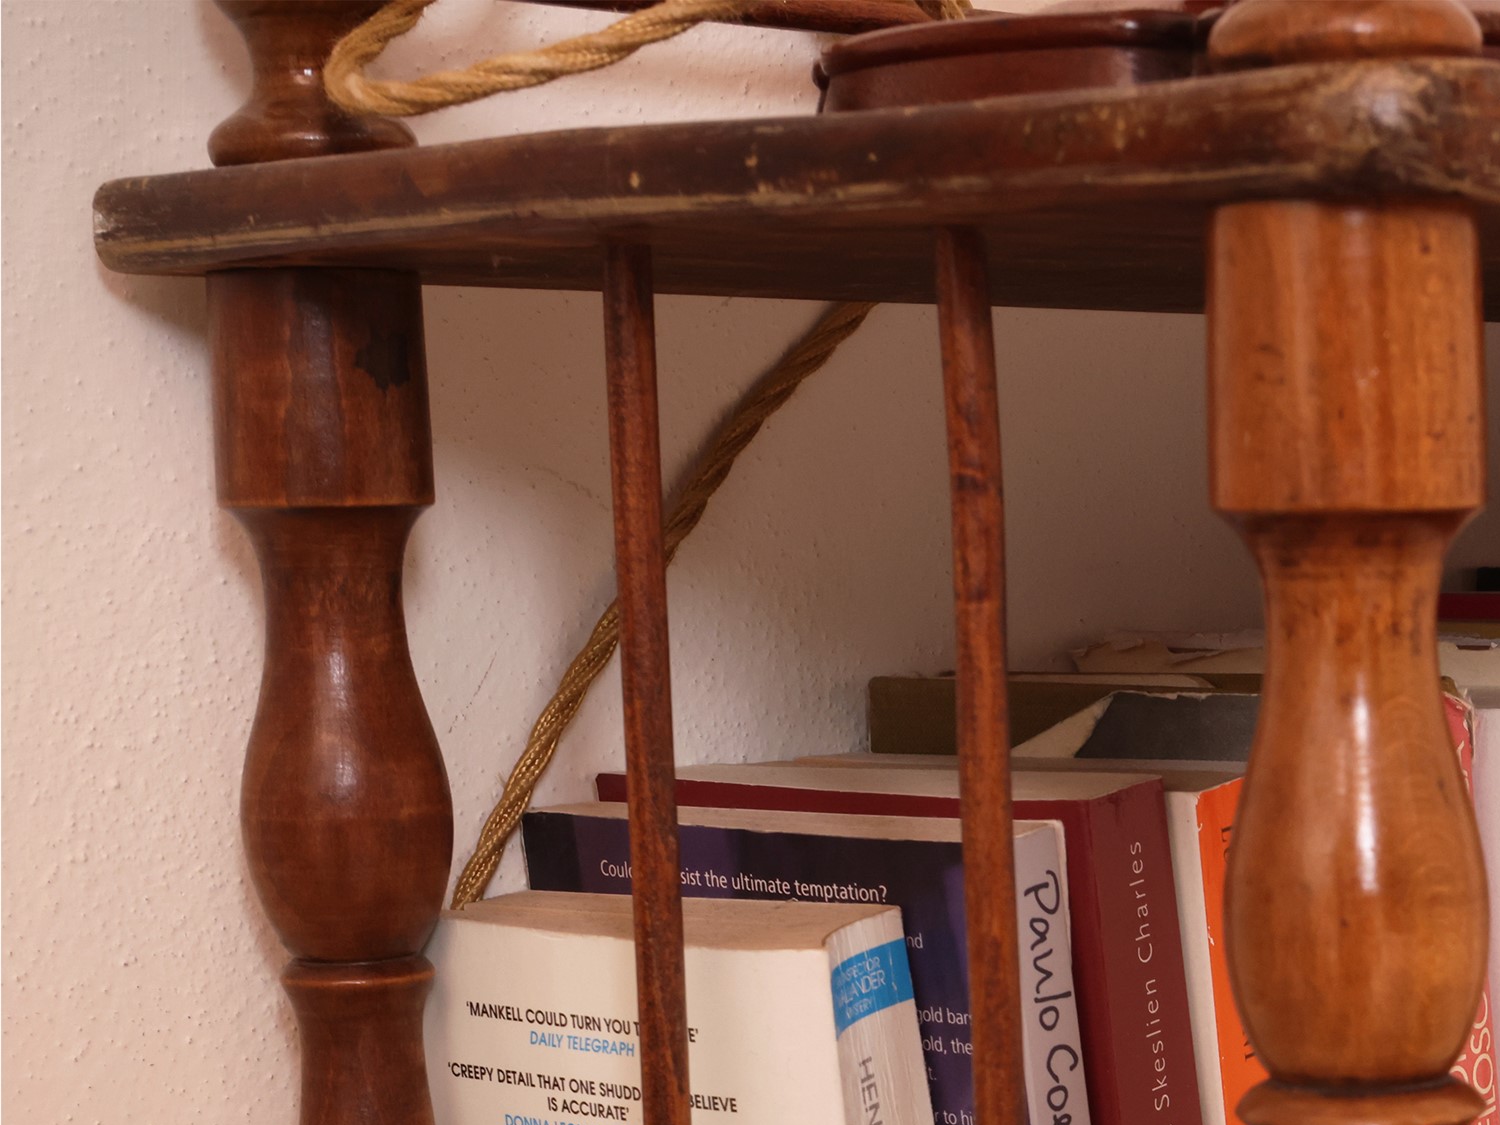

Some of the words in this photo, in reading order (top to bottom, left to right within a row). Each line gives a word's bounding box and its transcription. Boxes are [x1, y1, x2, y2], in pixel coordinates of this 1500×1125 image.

[704, 869, 728, 889] the
[731, 872, 791, 895] ultimate
[794, 879, 887, 903] temptation?
[1128, 840, 1156, 964] Charles
[1023, 868, 1073, 1032] Paulo
[526, 1009, 567, 1027] COULD
[571, 1014, 600, 1031] TURN
[604, 1018, 630, 1035] YOU
[530, 1030, 562, 1049] DAILY
[567, 1035, 635, 1057] TELEGRAPH
[1145, 978, 1172, 1113] Skeslien
[497, 1068, 535, 1087] DETAIL
[537, 1074, 565, 1092] THAT
[569, 1079, 596, 1096] ONE
